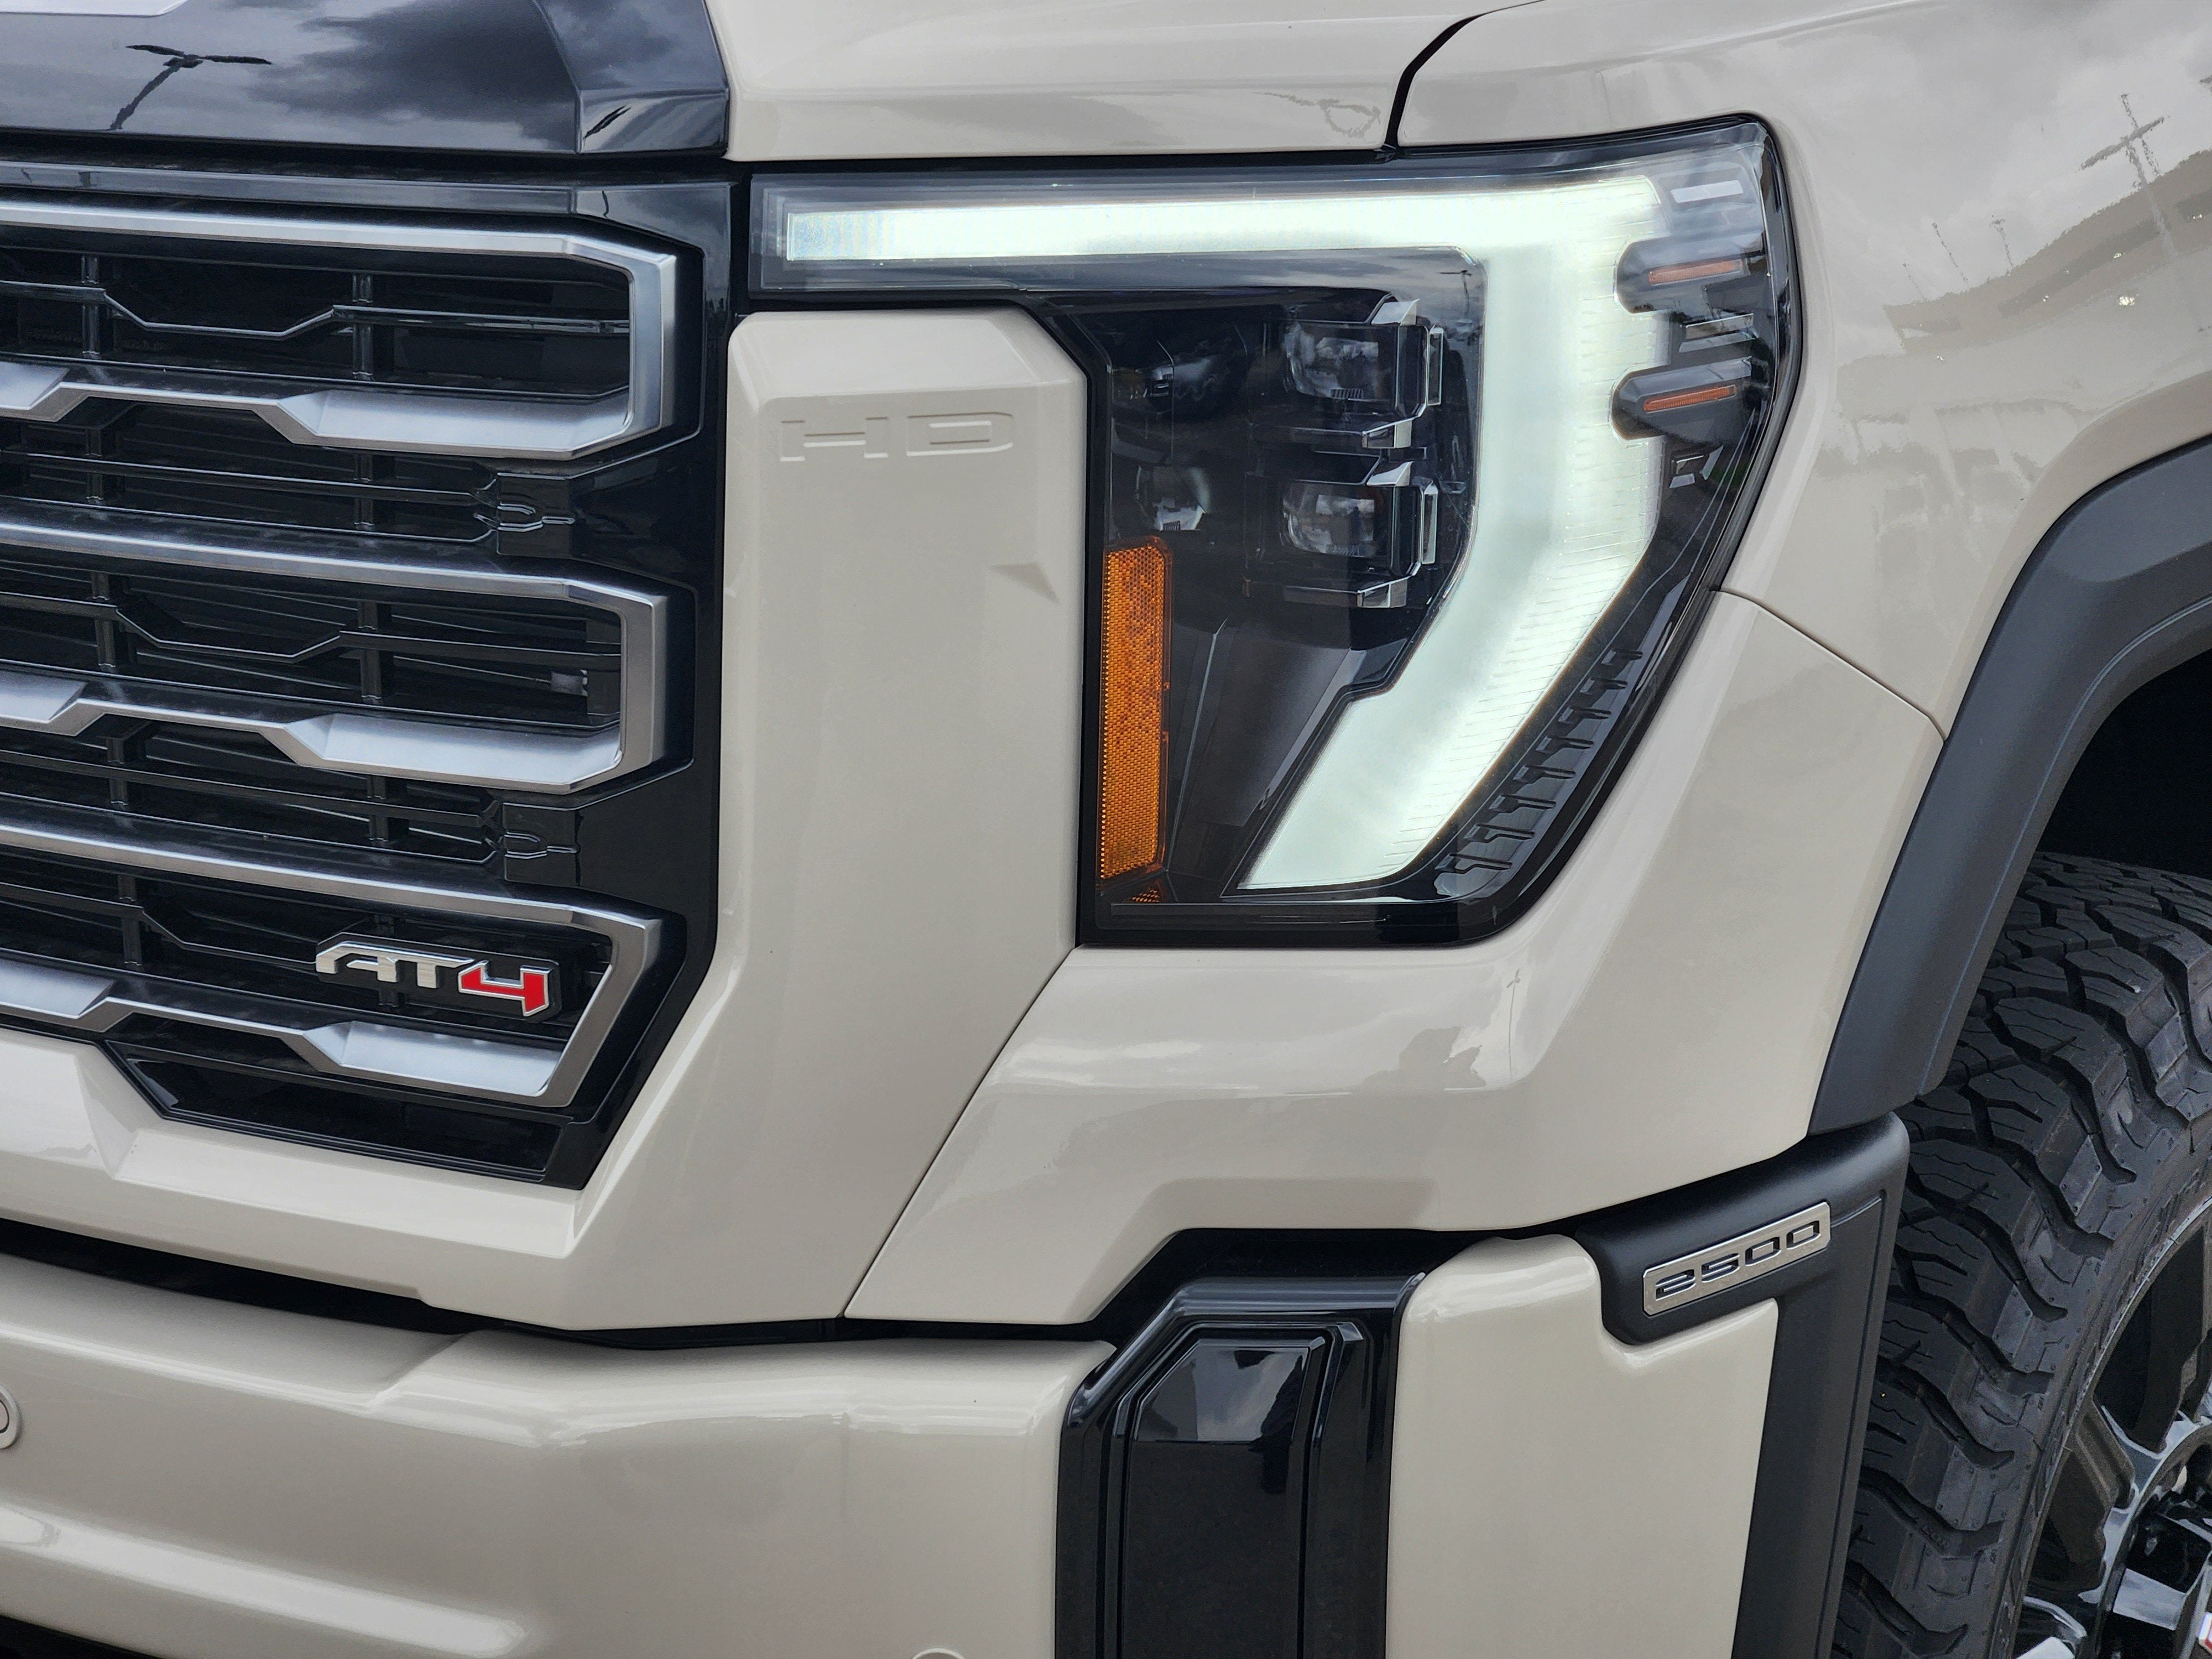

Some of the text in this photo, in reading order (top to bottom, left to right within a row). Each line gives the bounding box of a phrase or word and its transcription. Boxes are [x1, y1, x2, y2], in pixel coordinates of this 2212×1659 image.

[780, 411, 1013, 463] HD
[315, 941, 553, 1017] AT4
[1655, 1220, 1822, 1302] 2500
